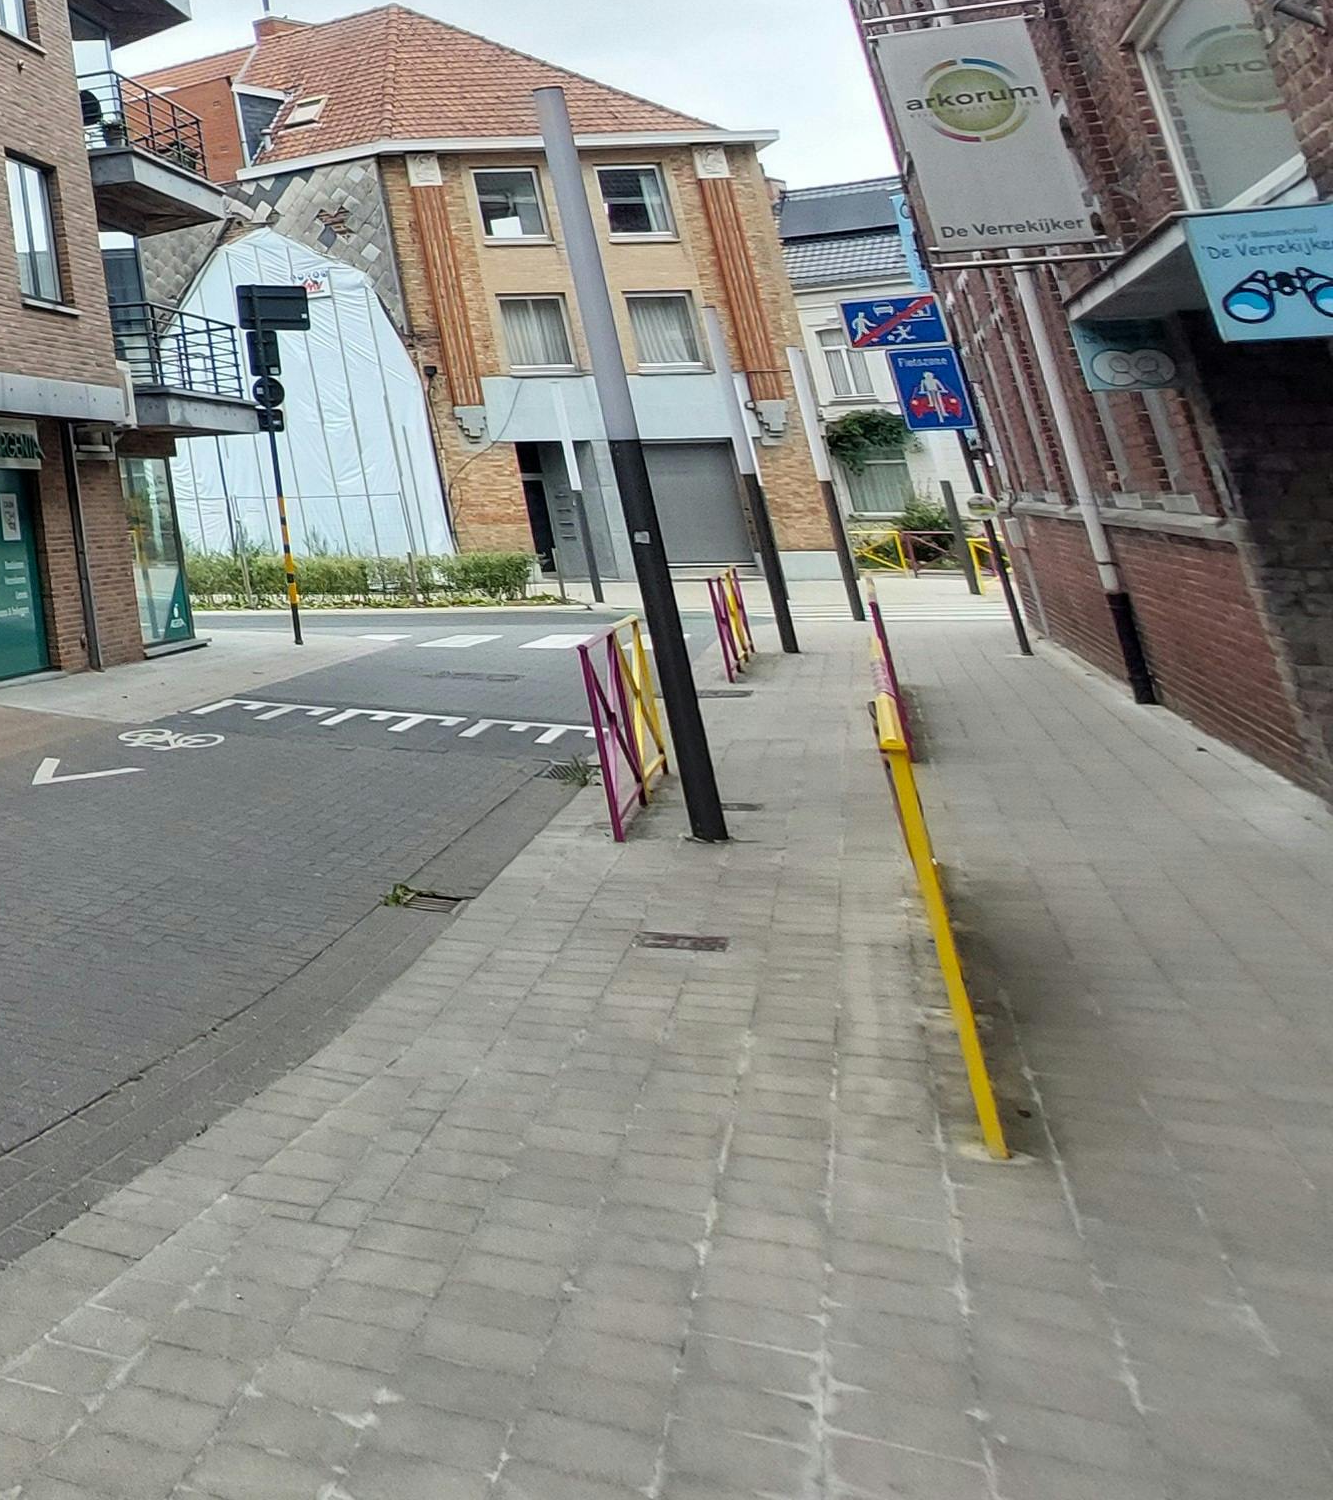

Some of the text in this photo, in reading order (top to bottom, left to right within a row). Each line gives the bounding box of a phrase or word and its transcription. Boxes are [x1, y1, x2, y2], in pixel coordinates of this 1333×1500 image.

[906, 85, 1038, 110] arkorum
[940, 218, 1084, 238] De Verrekijker
[1234, 236, 1333, 256] Verrekijke
